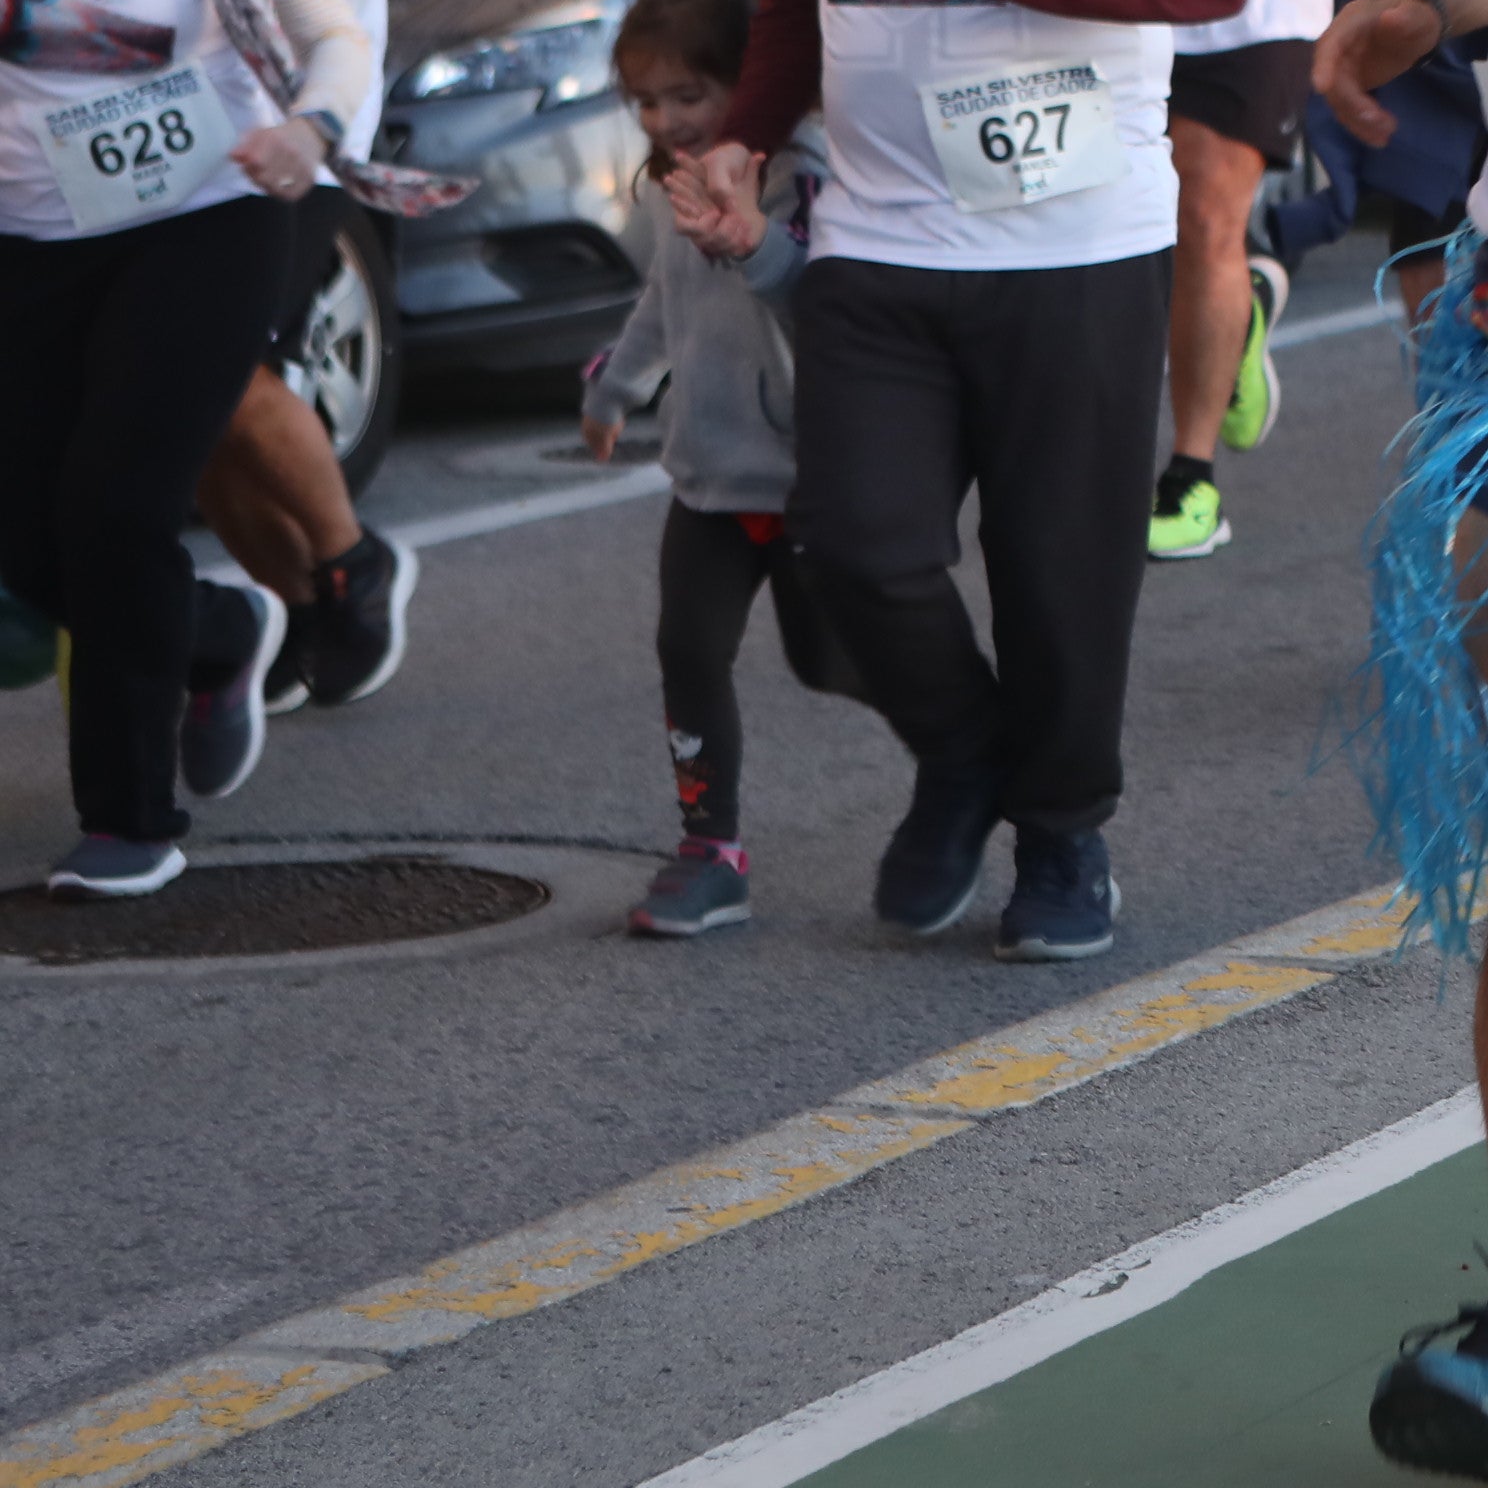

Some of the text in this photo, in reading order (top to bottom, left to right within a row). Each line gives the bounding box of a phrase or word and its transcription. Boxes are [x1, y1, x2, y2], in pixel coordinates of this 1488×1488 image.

[937, 67, 1096, 104] SAN SILVESTRE
[940, 91, 1014, 118] CIUDAD
[1017, 87, 1039, 105] DE
[90, 109, 195, 177] 628
[979, 103, 1071, 164] 627
